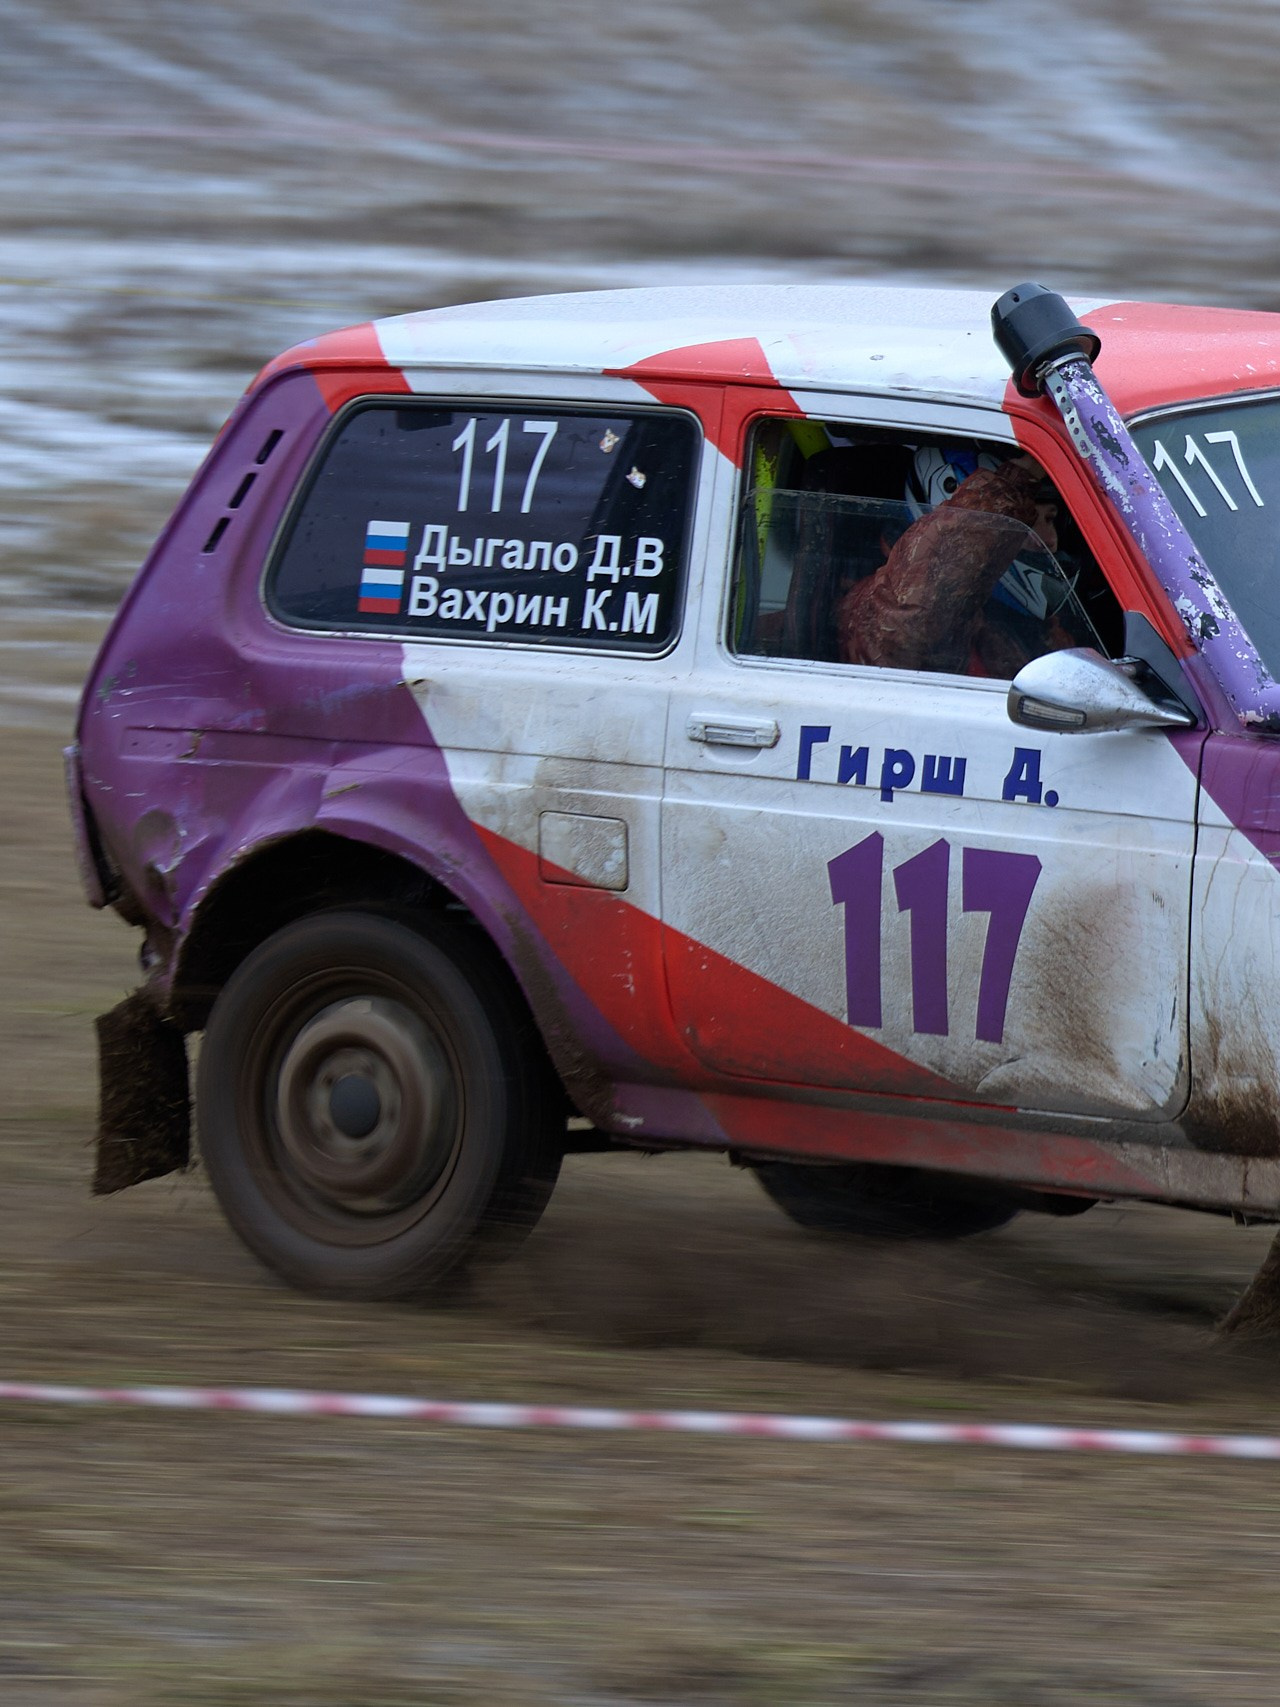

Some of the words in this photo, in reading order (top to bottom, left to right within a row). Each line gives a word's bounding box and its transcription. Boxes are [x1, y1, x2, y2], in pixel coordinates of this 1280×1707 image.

[451, 417, 559, 514] 117
[1151, 430, 1265, 518] 117
[413, 524, 579, 573] Дыгало
[586, 534, 665, 583] Д.В
[407, 575, 570, 633] Вахрин
[580, 587, 660, 635] К.М
[796, 725, 968, 803] Гирш
[1001, 746, 1060, 808] Д.
[826, 830, 1043, 1045] 117
